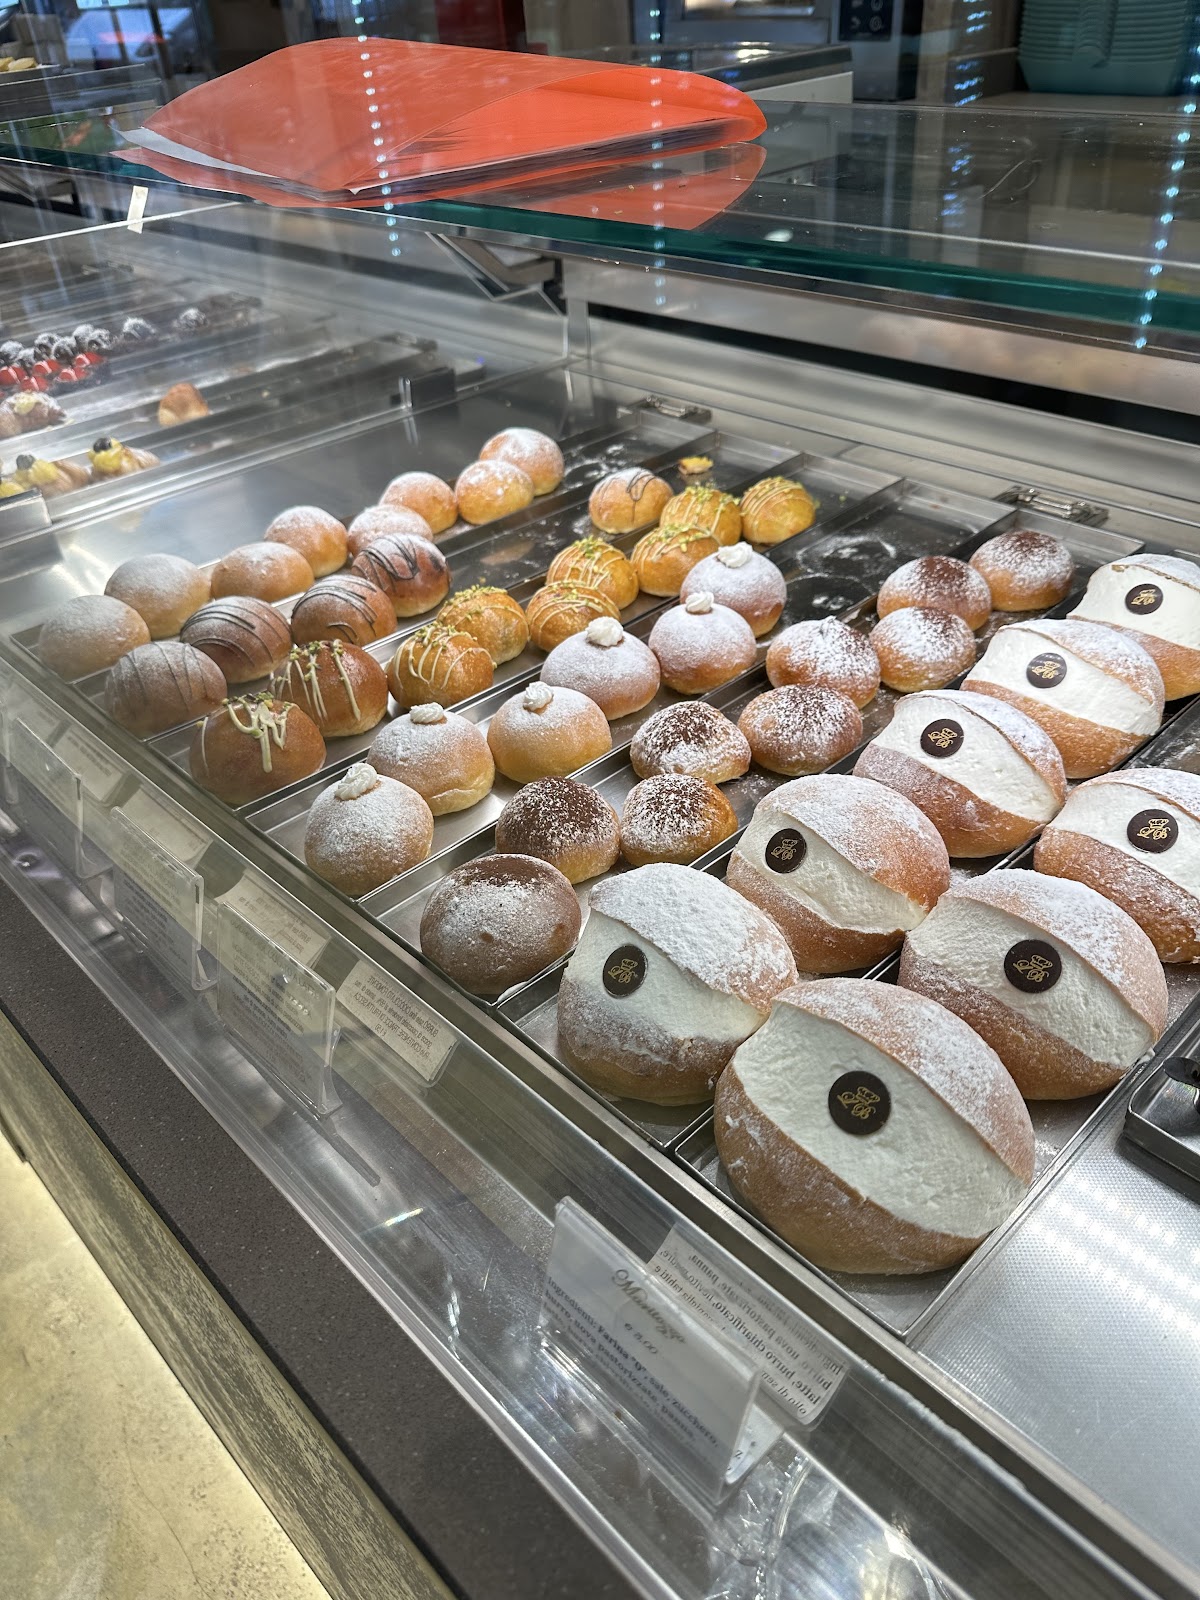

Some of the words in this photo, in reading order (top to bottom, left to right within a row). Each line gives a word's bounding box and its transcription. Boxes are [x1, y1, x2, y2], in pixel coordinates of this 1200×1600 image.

[544, 1288, 573, 1323] burro,
[574, 1318, 596, 1344] uova
[597, 1341, 660, 1406] pastorizzate,
[660, 1404, 696, 1442] panna,
[547, 1275, 597, 1329] Ingredienti:
[597, 1324, 629, 1360] Farina
[648, 1374, 672, 1401] sale,
[672, 1397, 720, 1448] zucchero,
[612, 1269, 686, 1344] Maritozzo
